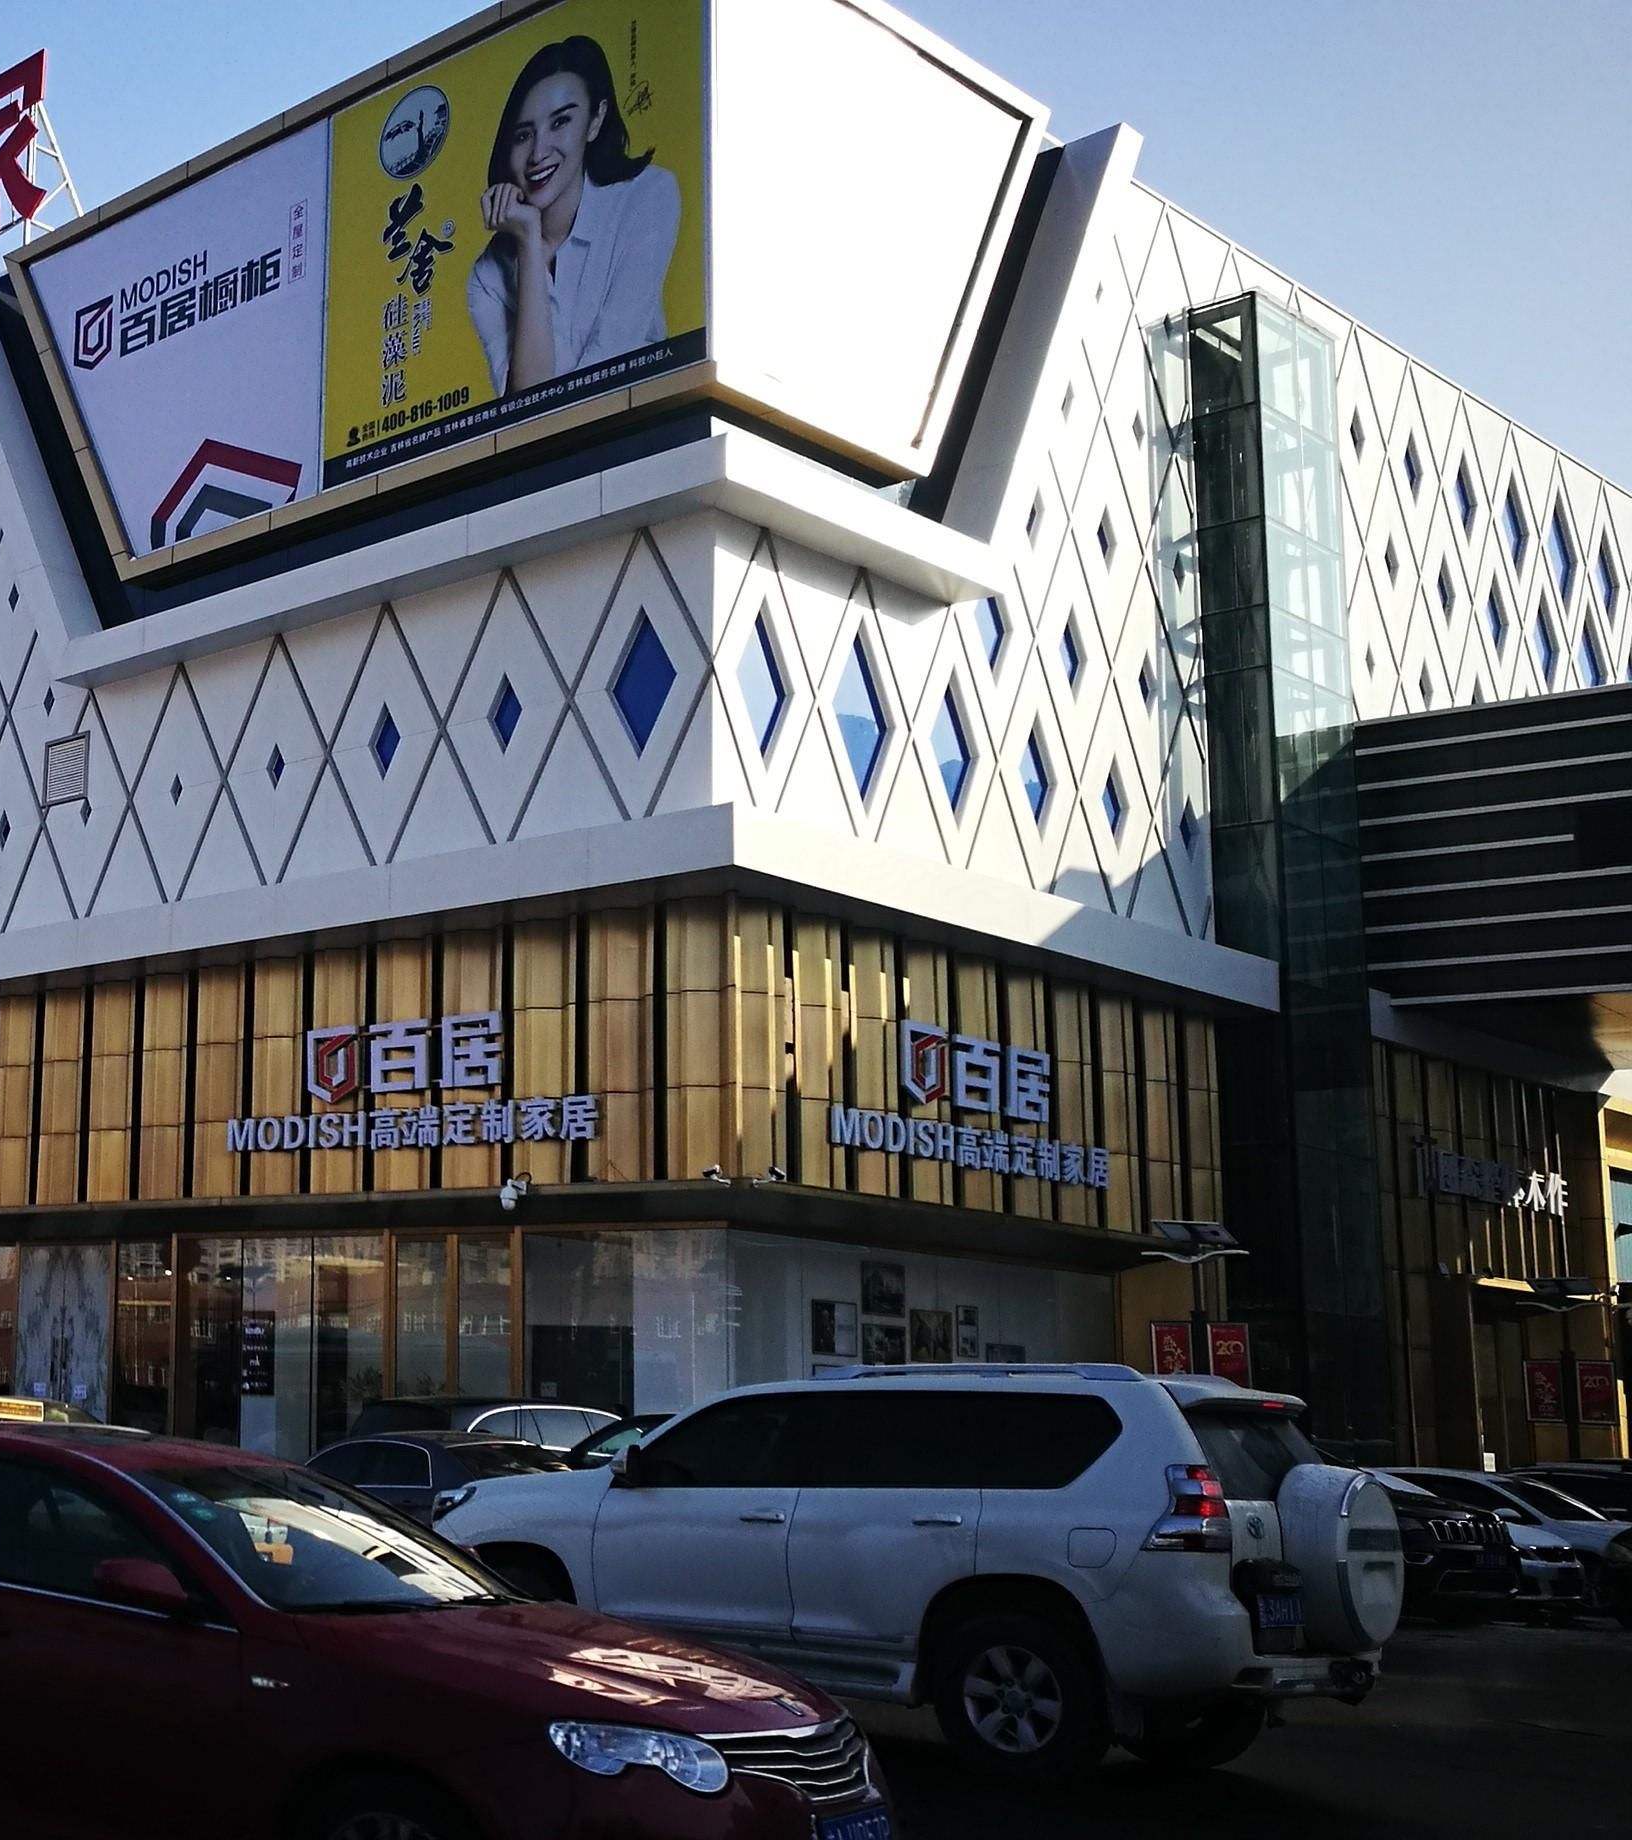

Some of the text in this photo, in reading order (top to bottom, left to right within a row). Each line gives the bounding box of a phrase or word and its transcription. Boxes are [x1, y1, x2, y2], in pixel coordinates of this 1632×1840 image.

[119, 250, 208, 314] MODISH
[291, 204, 304, 279] 全屋定制
[119, 247, 282, 358] 百居橱柜
[382, 293, 409, 406] 硅藻泥
[345, 347, 674, 469] 高新技术企业 吉林省名牌产品 吉林省著名商标 省级企业技术中心 吉林省服务名牌 科技小巨人
[381, 386, 470, 433] 400-816-1009
[369, 1010, 503, 1093] 百居
[951, 1033, 1051, 1124] 百居
